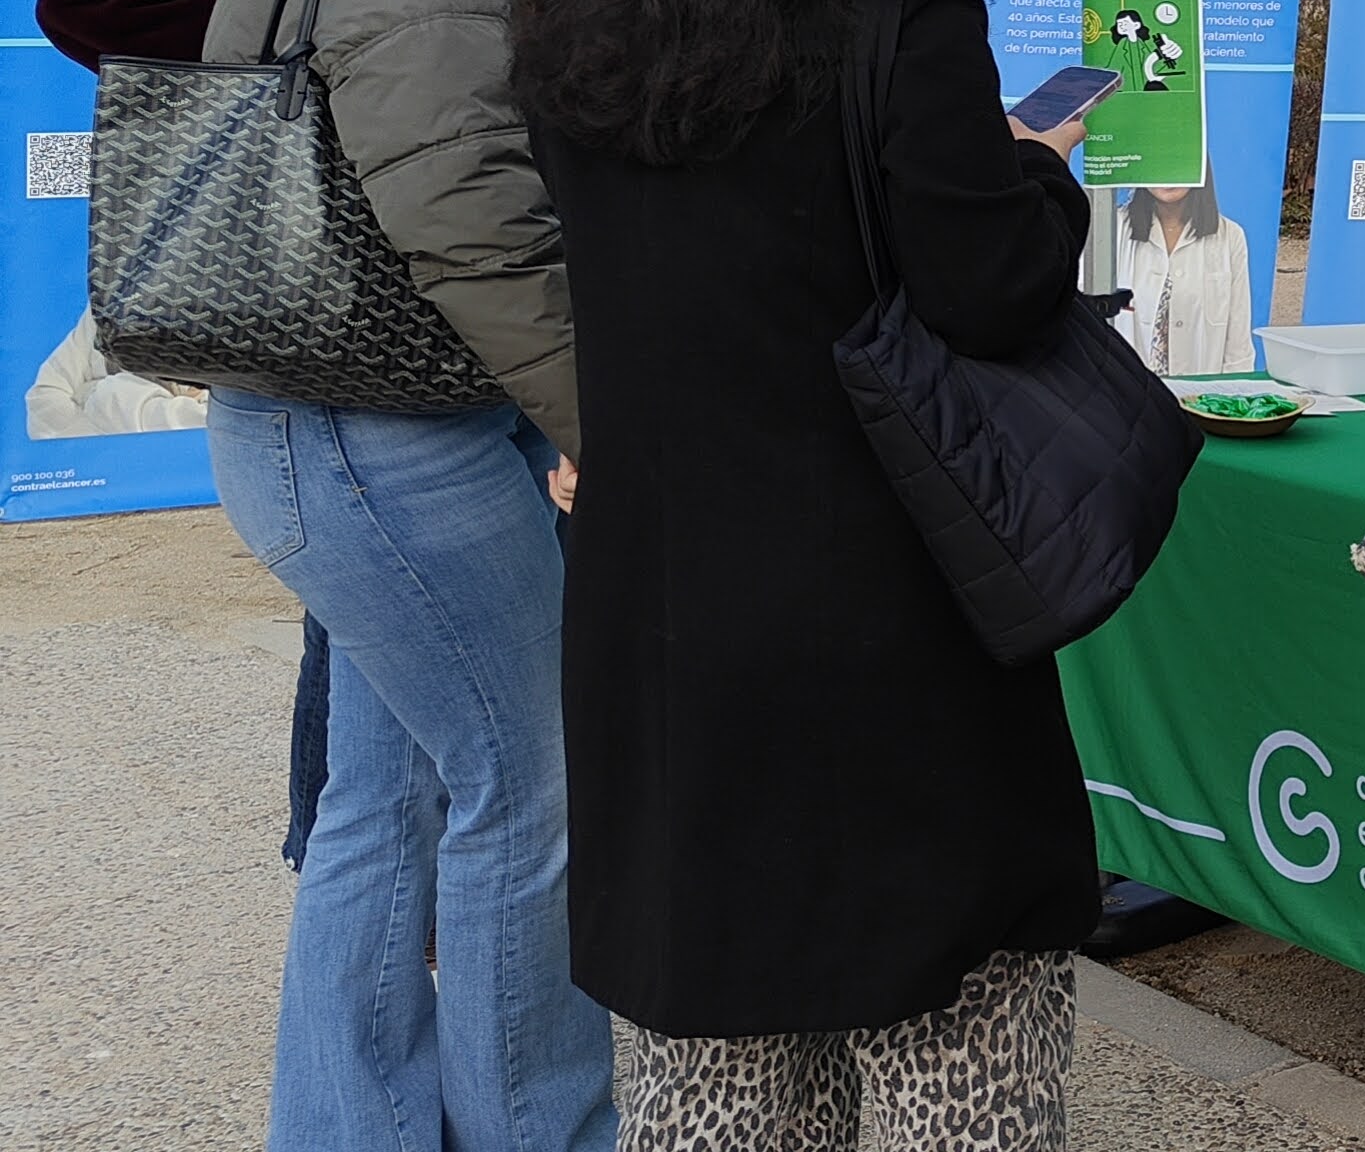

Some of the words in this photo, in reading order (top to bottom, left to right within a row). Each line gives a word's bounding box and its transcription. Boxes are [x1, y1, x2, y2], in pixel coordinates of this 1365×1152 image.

[11, 472, 31, 483] 900
[34, 470, 53, 481] 100
[55, 469, 75, 481] 036
[11, 477, 106, 493] contraelcancer.es
